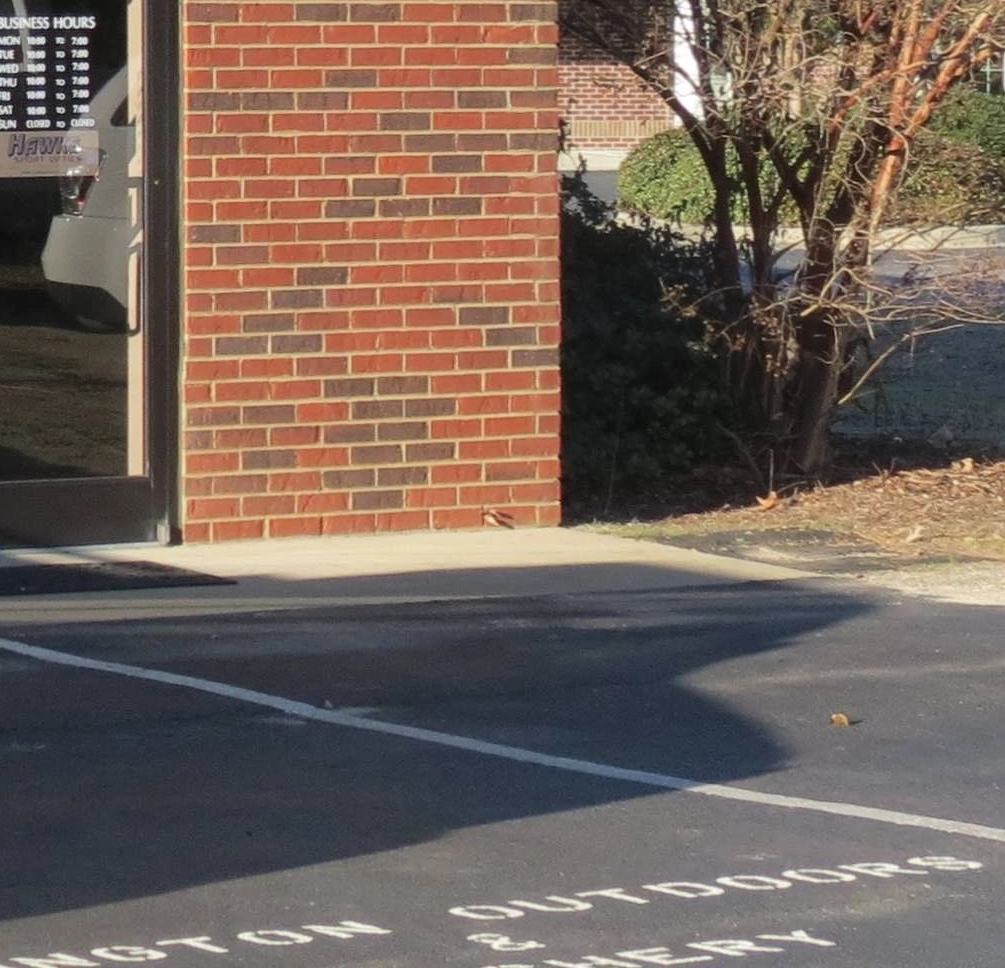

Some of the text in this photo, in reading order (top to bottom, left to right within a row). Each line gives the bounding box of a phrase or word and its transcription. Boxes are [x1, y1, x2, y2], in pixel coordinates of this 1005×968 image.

[53, 16, 96, 29] HOURS
[26, 119, 51, 128] CLOSED
[70, 118, 95, 127] CLOSED
[448, 855, 984, 920] OUTDOORS
[467, 932, 545, 951] &
